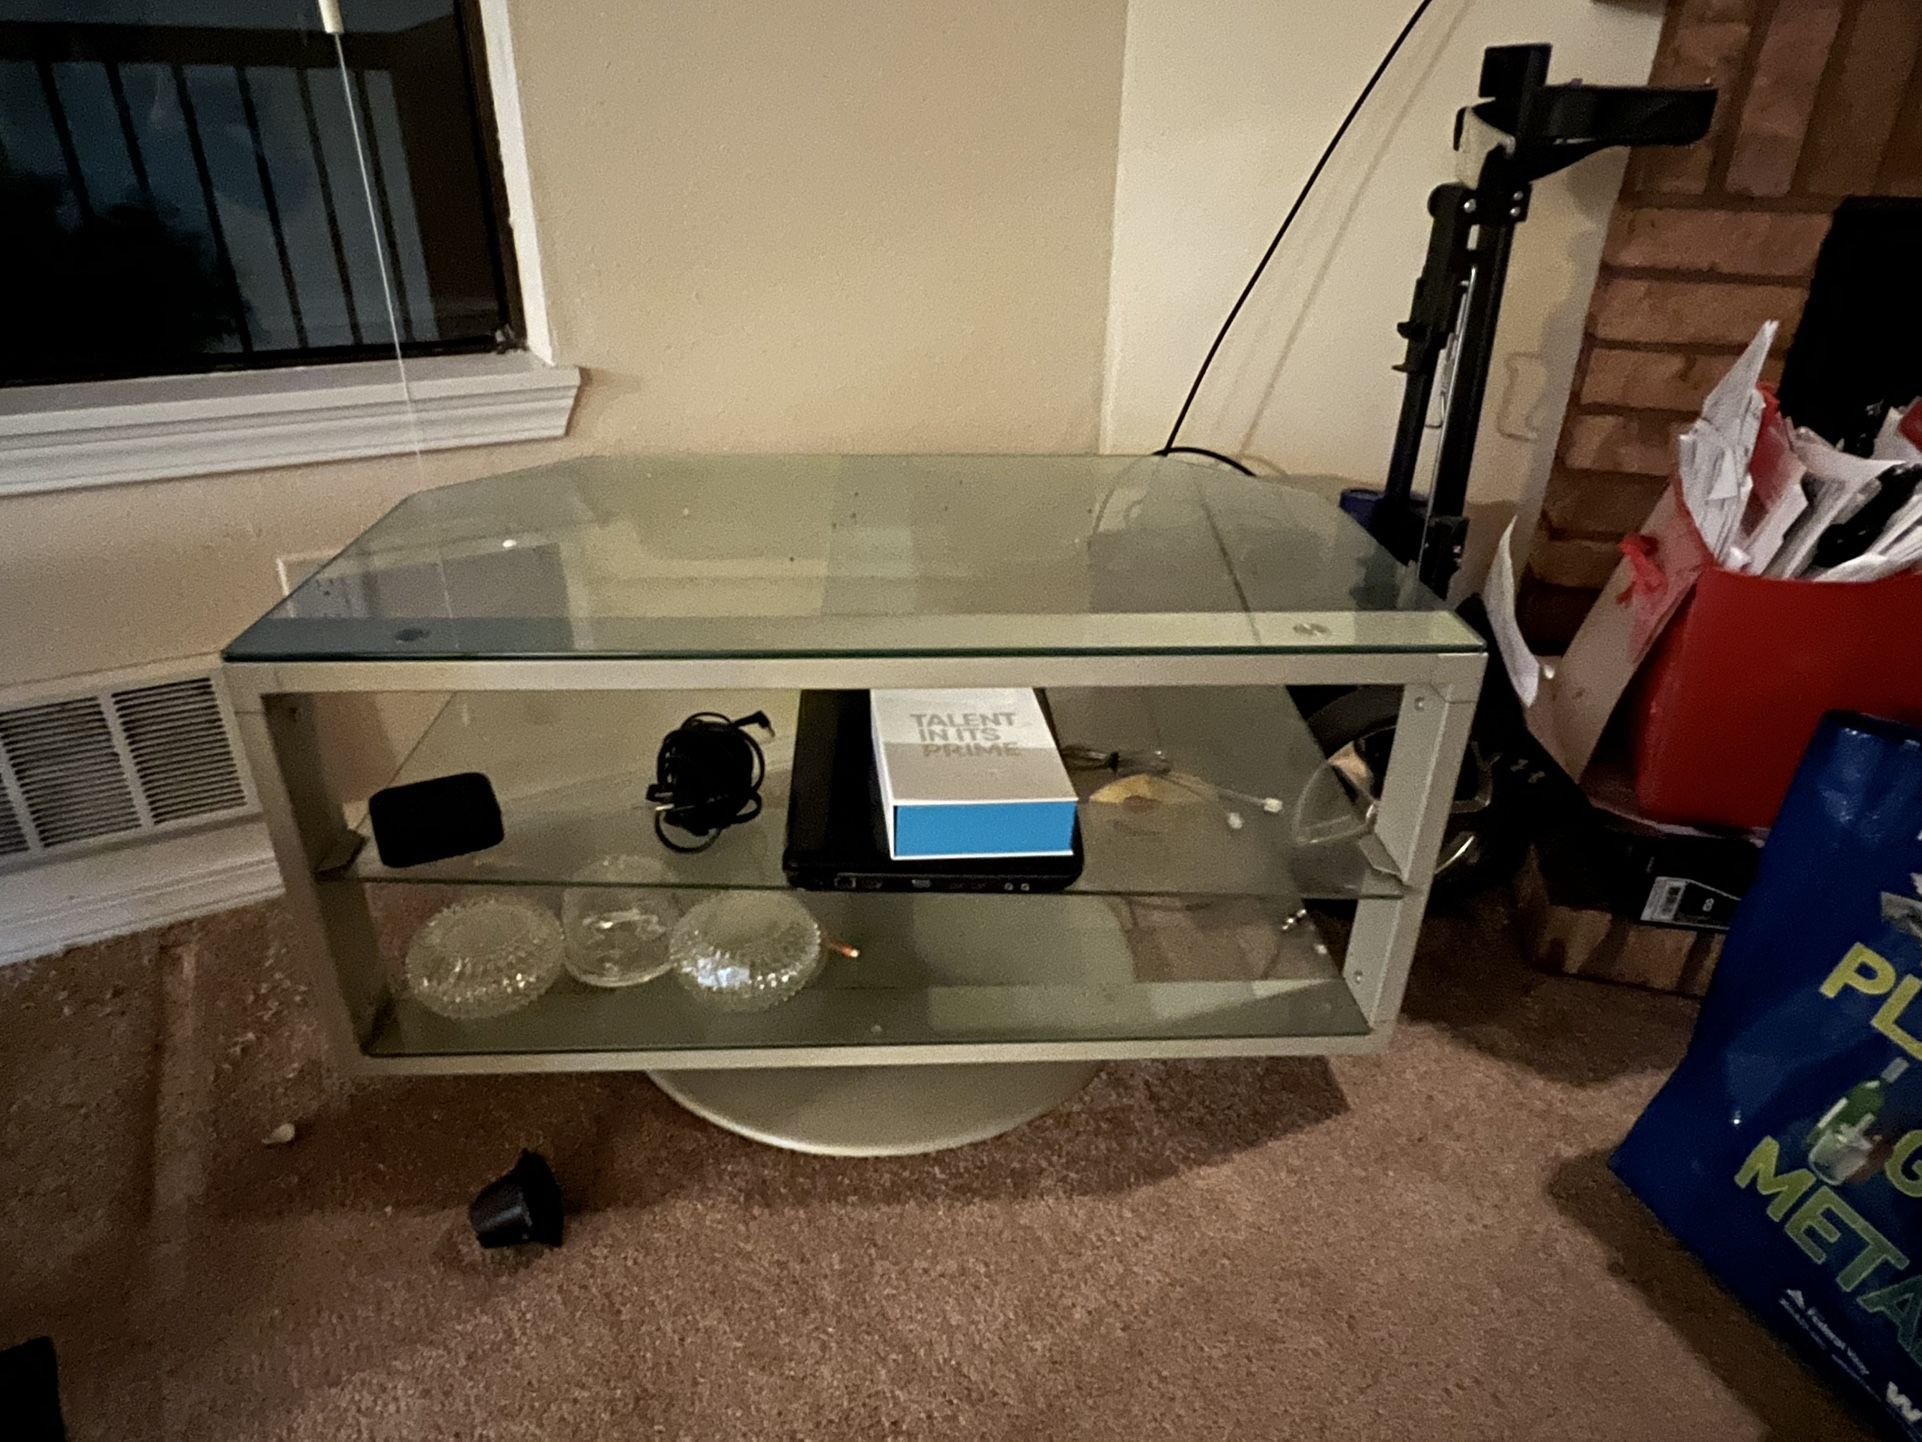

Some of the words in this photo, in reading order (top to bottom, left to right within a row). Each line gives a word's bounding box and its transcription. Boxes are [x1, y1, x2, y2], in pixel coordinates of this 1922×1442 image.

[910, 712, 1016, 728] TALENT
[918, 728, 949, 742] IN
[956, 728, 1001, 742] ITS
[921, 742, 1021, 757] PRIME
[1734, 1135, 1922, 1369] META
